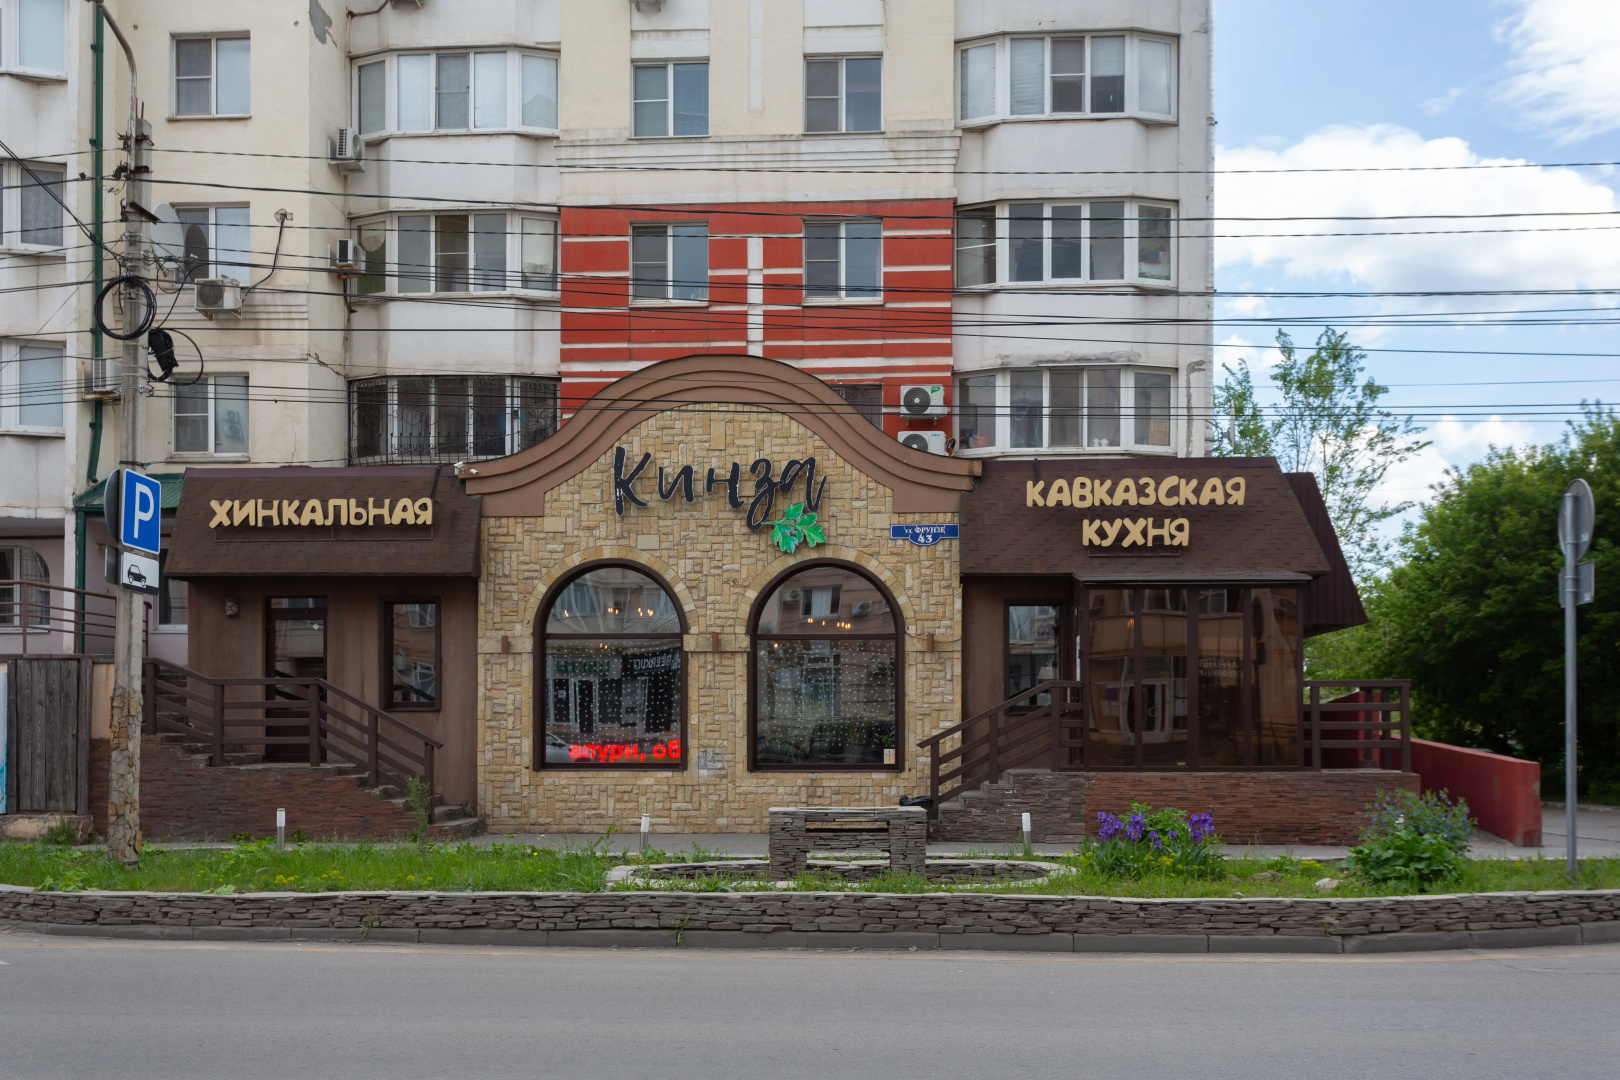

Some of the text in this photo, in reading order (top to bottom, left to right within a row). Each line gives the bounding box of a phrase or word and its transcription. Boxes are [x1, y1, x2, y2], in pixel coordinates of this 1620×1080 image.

[614, 446, 827, 531] Кинза
[1026, 475, 1246, 508] КАВКАЗСКАЯ
[133, 482, 155, 539] P
[209, 497, 433, 528] ХИНКАЛЬНАЯ
[914, 526, 946, 534] ФРУНЗЕ
[917, 534, 933, 543] 43
[1082, 517, 1190, 548] КУХНЯ
